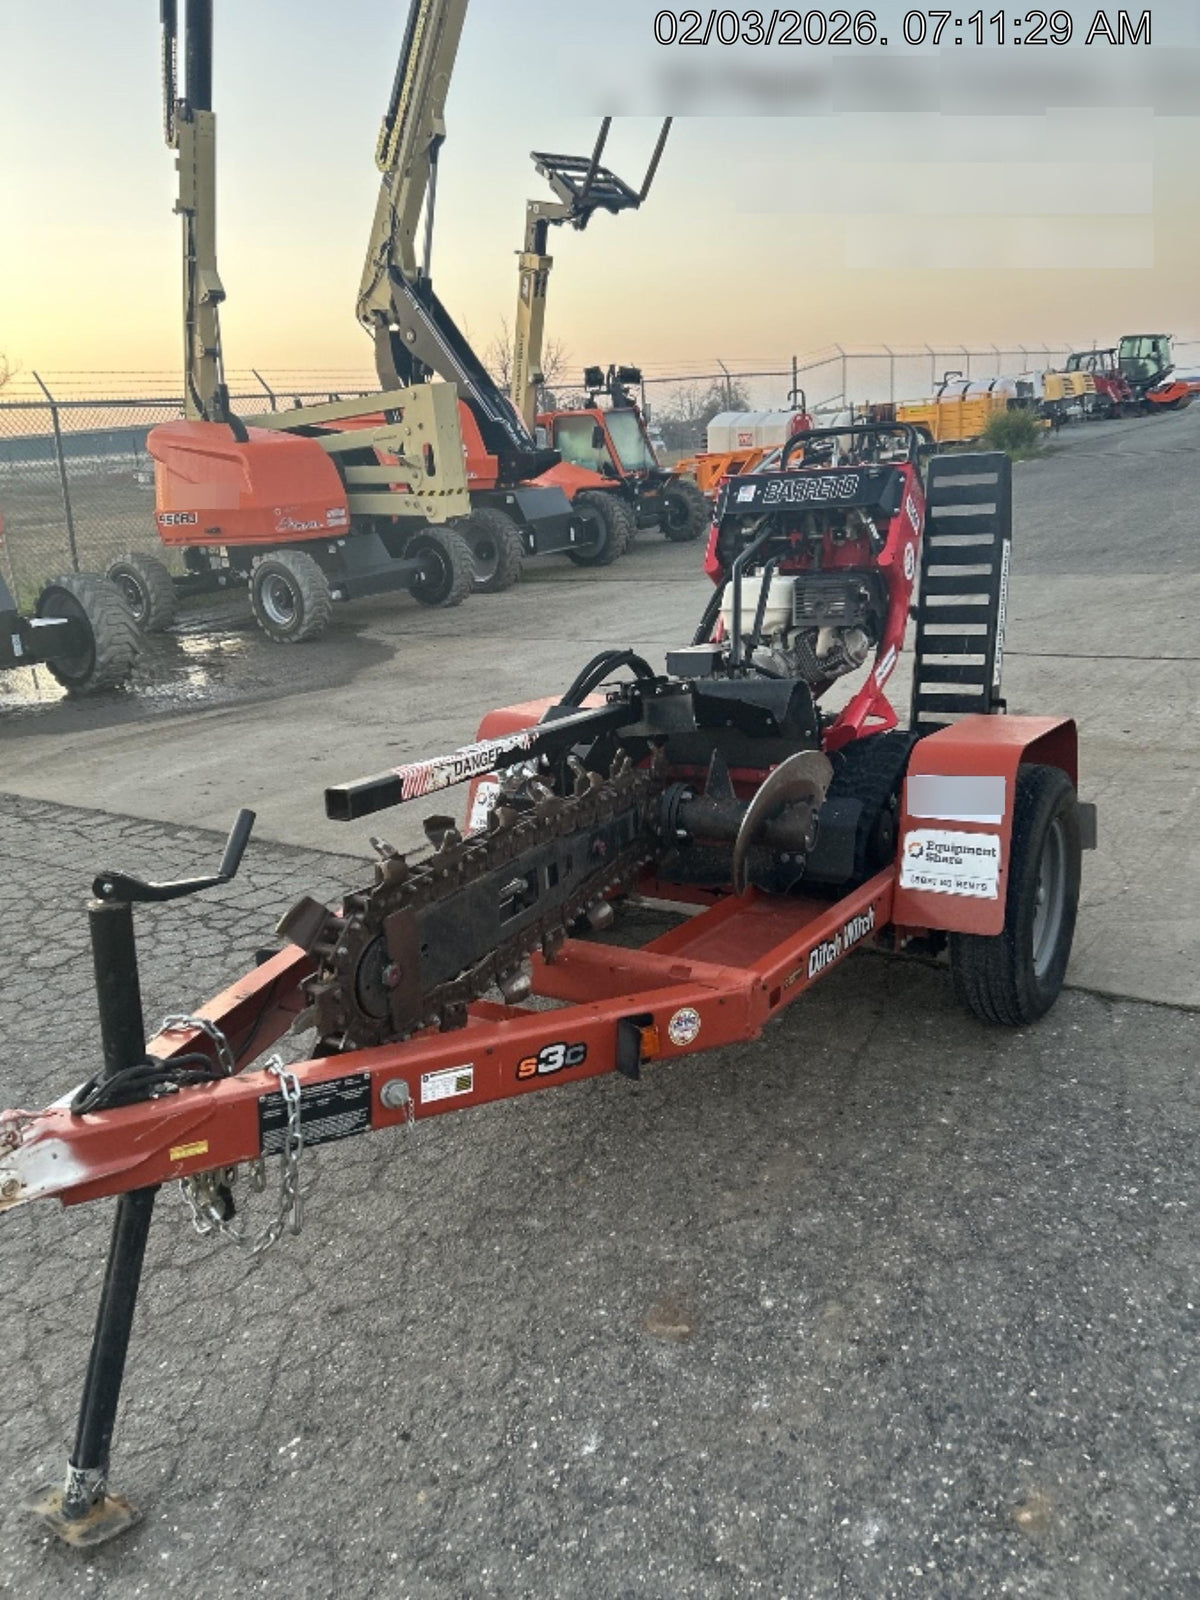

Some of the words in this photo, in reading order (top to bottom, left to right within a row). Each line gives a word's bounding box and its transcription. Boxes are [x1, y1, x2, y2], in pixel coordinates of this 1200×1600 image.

[762, 474, 860, 504] BARRETO
[925, 840, 997, 858] Equipment
[925, 852, 963, 865] Share
[808, 932, 842, 979] Ditch
